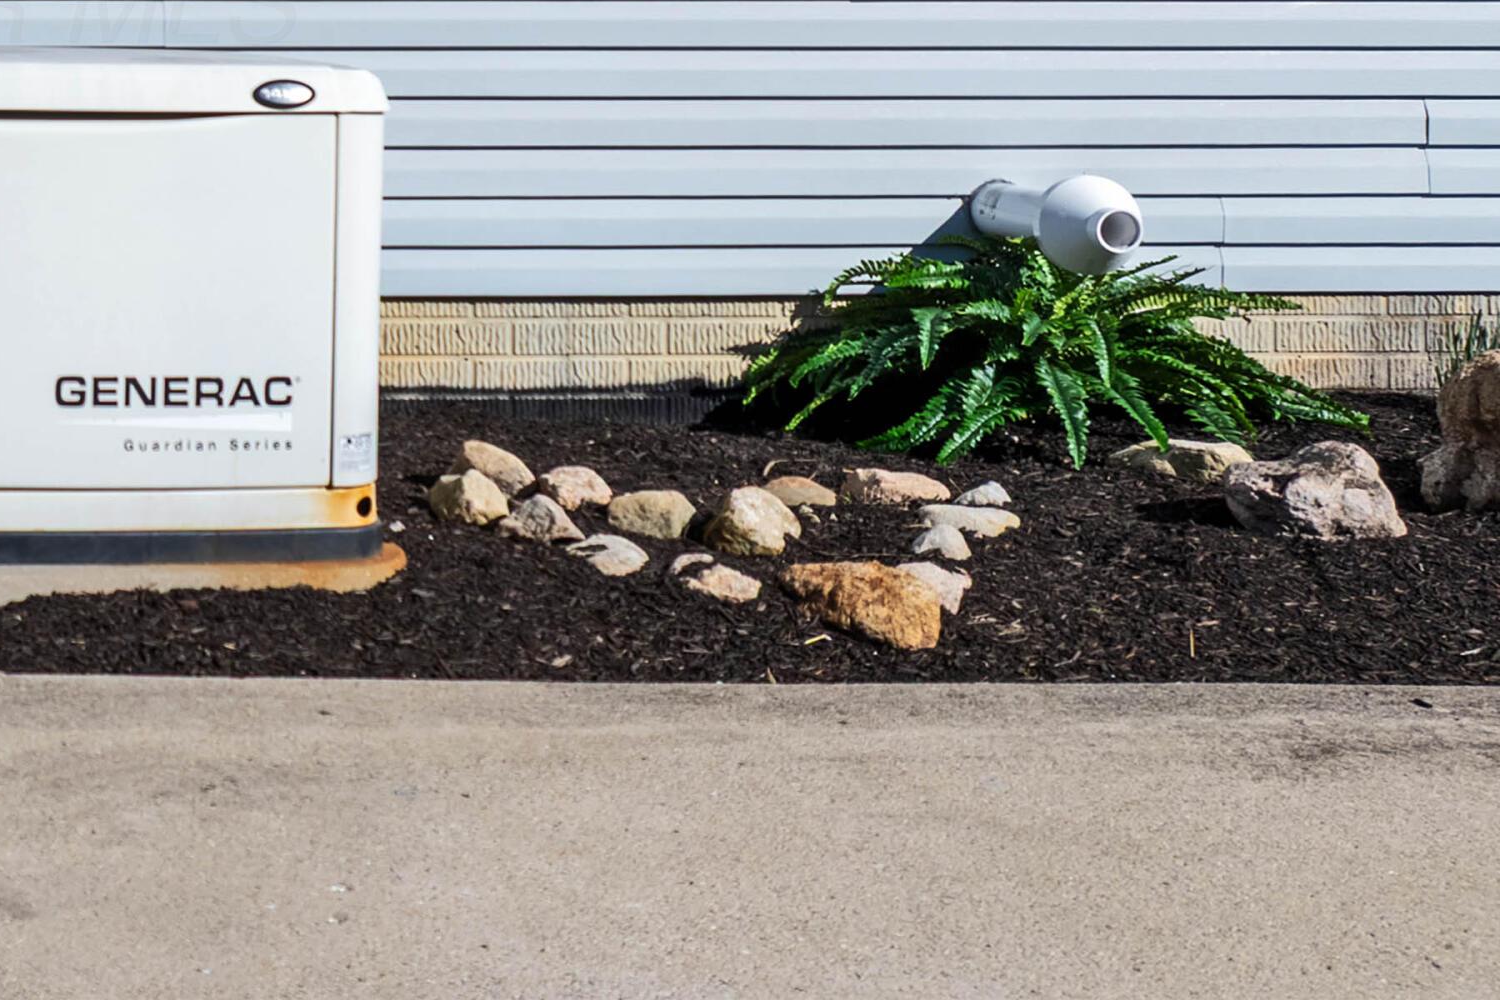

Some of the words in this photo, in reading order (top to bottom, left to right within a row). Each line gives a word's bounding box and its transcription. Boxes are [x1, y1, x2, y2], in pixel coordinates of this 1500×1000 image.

[55, 375, 294, 408] GENERAC
[123, 438, 217, 452] Guardian
[229, 437, 294, 451] Series
